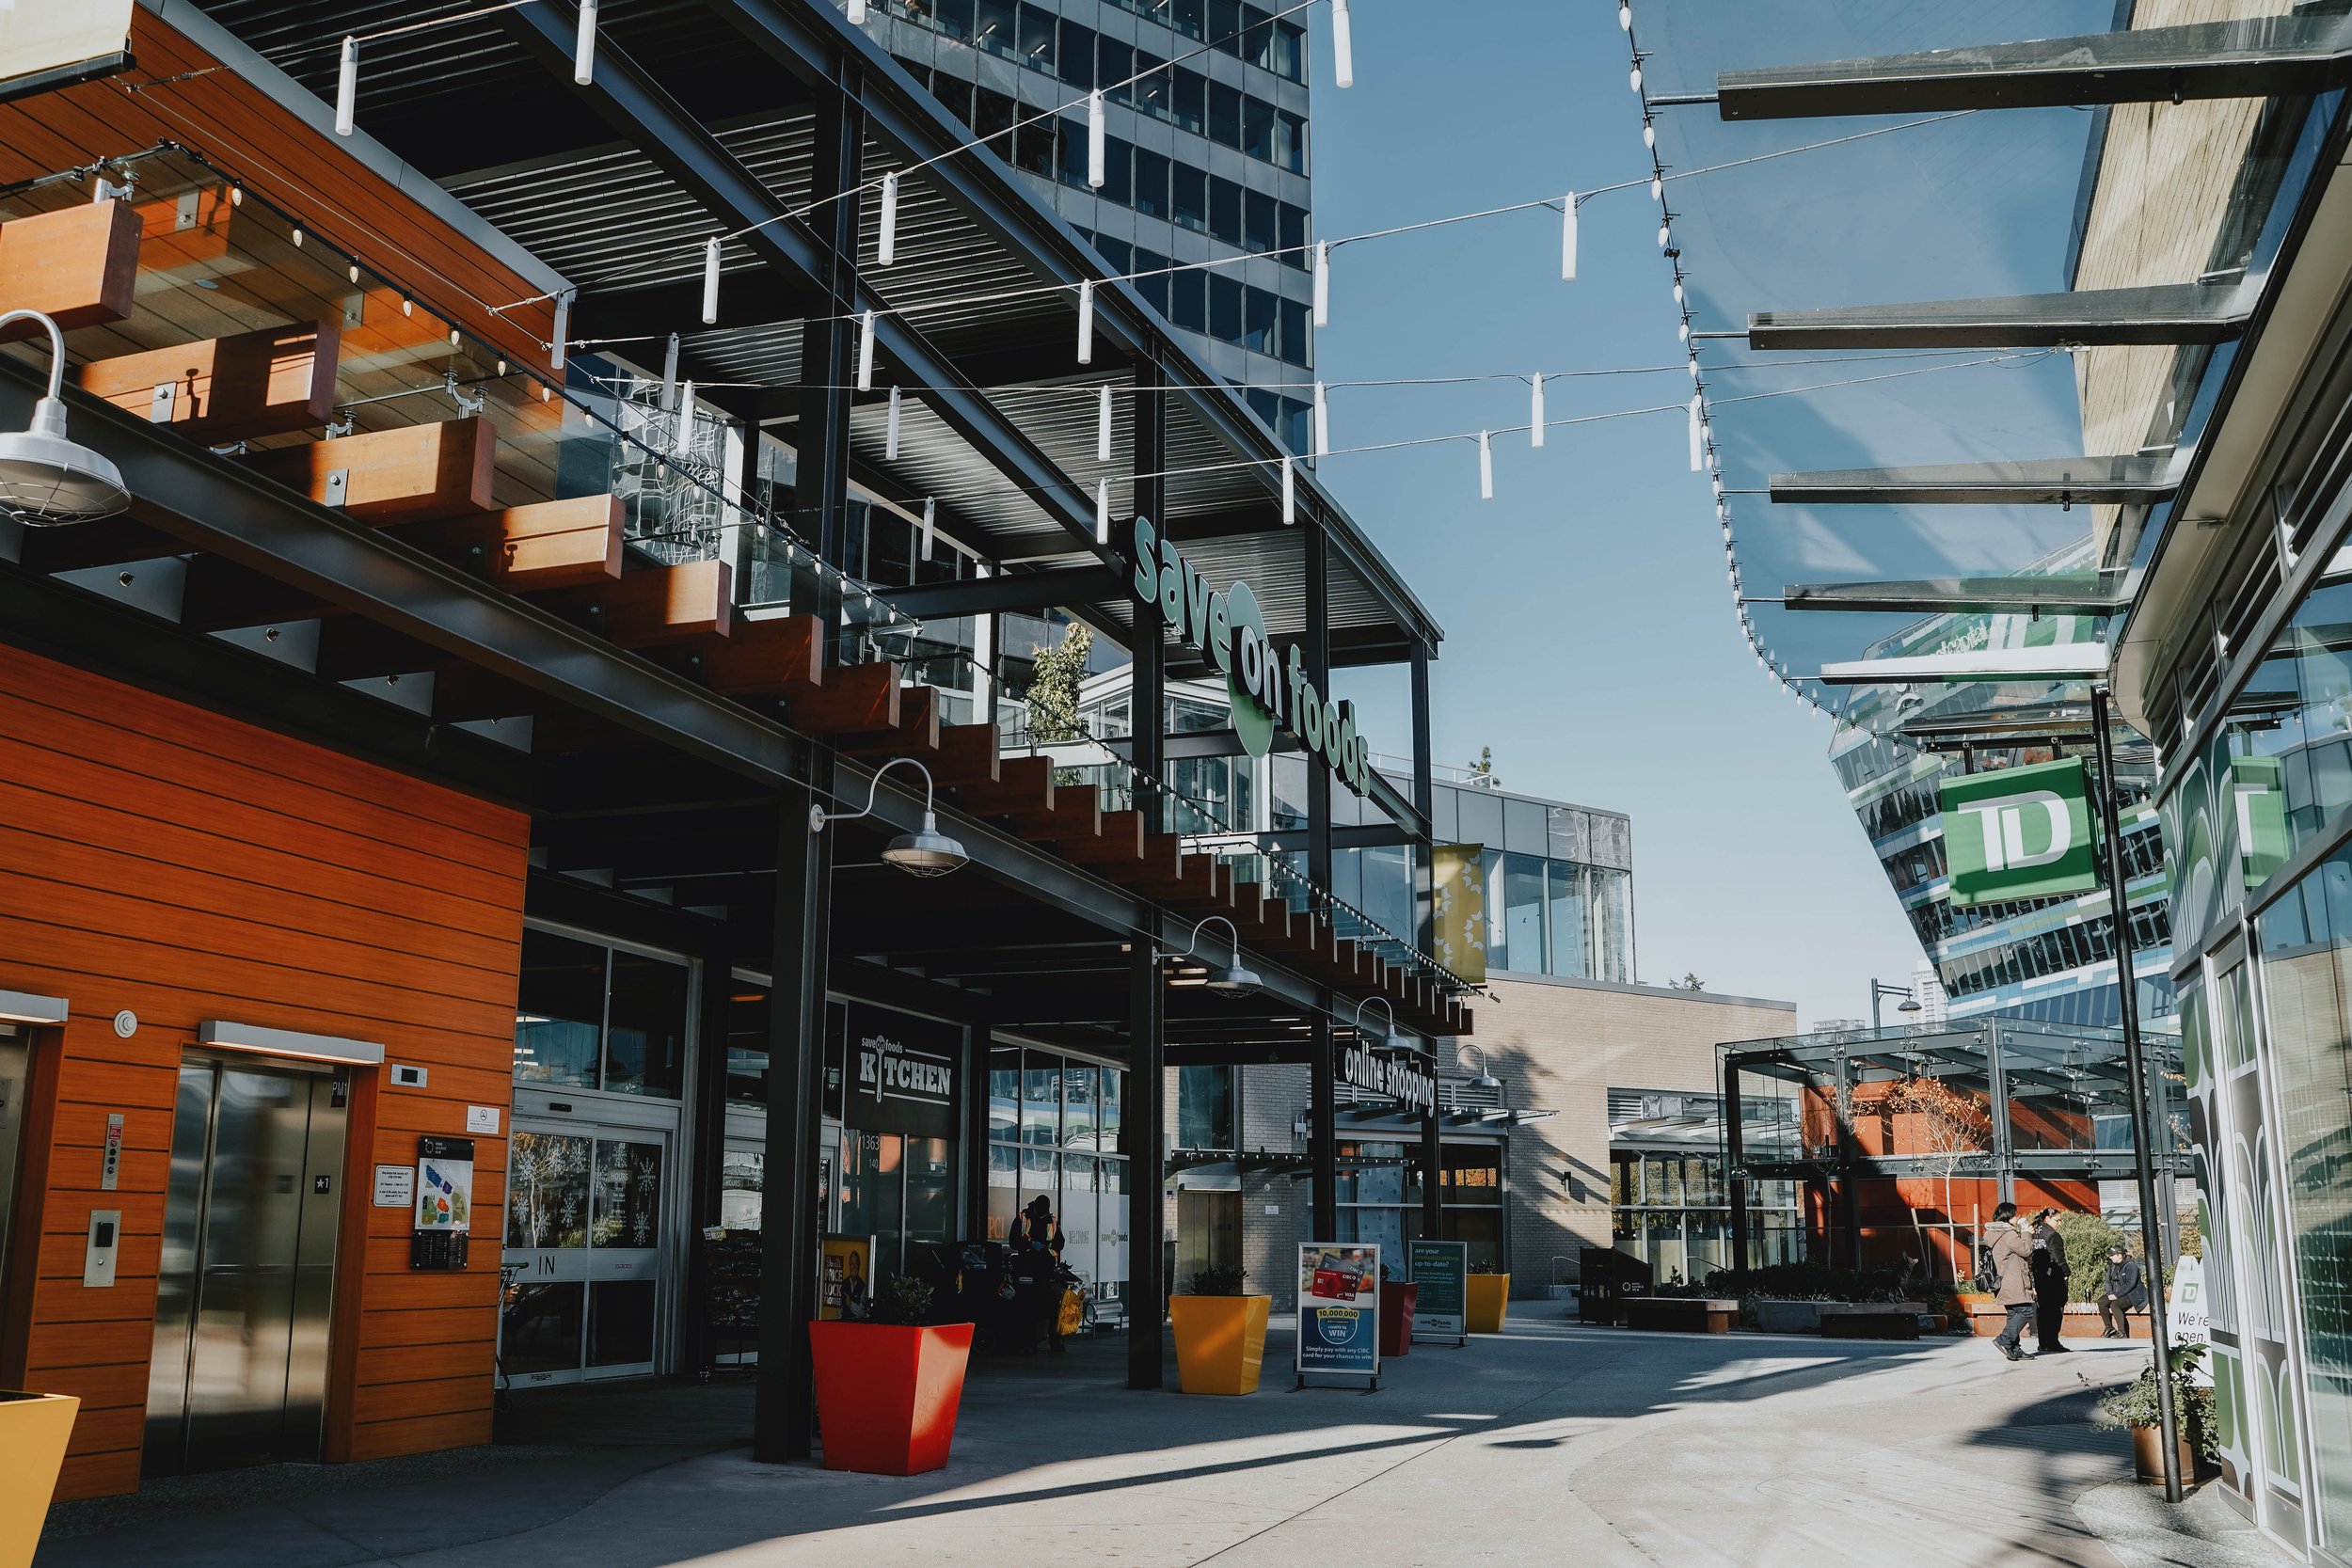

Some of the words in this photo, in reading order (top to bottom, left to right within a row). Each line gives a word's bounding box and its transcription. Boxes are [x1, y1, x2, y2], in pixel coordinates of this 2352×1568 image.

[1135, 515, 1232, 673] save
[1239, 624, 1282, 720] on
[1287, 642, 1371, 798] foods
[1957, 789, 2072, 873] TD
[862, 1037, 876, 1049] save
[884, 1038, 903, 1053] foods
[860, 1052, 951, 1096] KITCHEN
[1344, 1039, 1384, 1092] online
[1386, 1052, 1435, 1118] shopping
[332, 1081, 347, 1097] PM1
[869, 1158, 879, 1169] 140
[611, 1172, 628, 1181] HOURS
[1068, 1229, 1089, 1244] WELCOMING
[538, 1255, 555, 1275] IN
[824, 1282, 842, 1297] LOCK
[1318, 1309, 1359, 1318] 10,000,000
[2178, 1311, 2210, 1327] We're
[1328, 1329, 1346, 1338] WIN
[2174, 1331, 2207, 1345] open.
